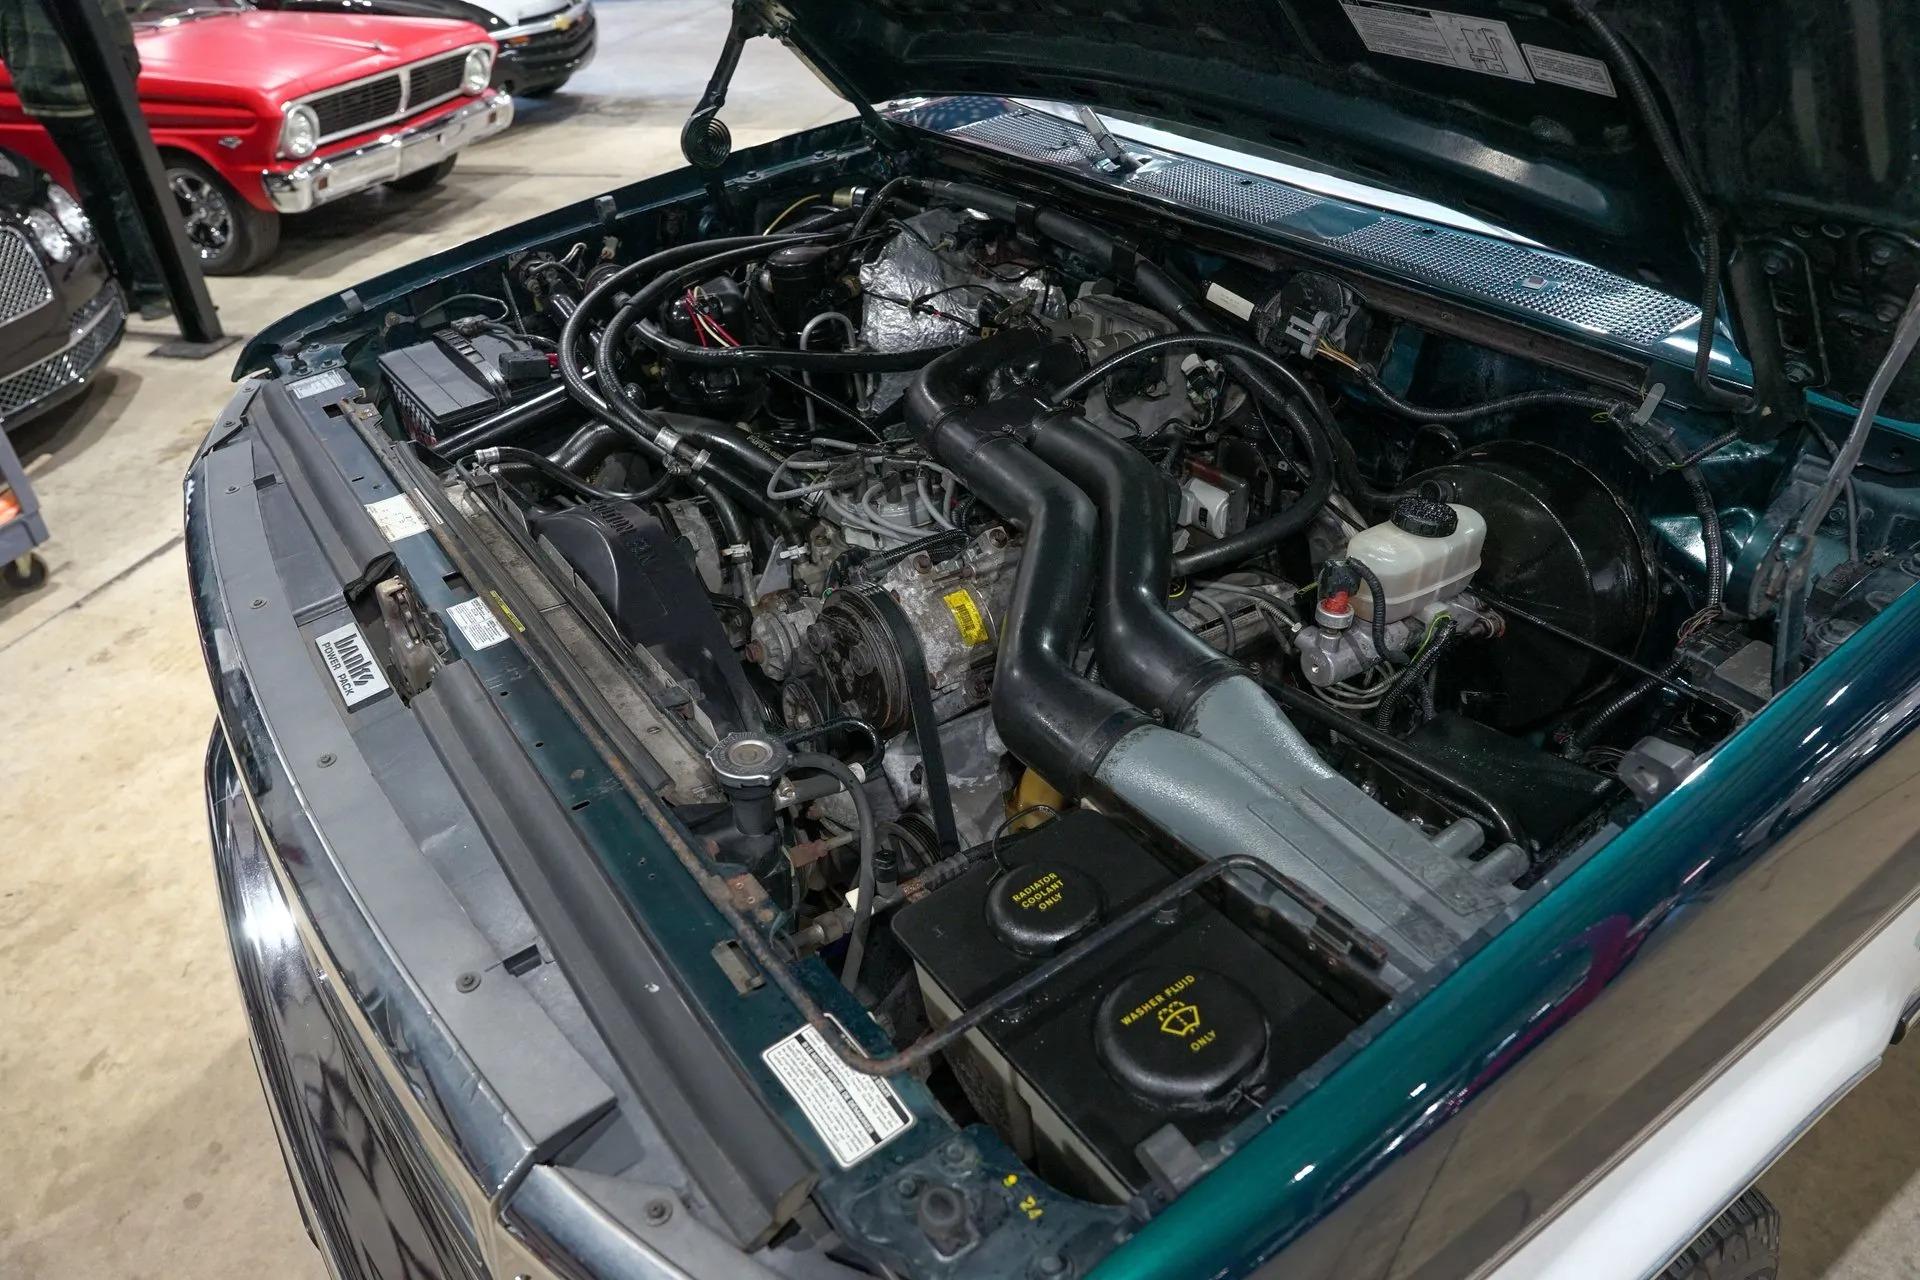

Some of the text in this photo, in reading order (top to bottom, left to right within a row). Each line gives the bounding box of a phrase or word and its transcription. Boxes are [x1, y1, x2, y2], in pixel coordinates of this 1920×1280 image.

[321, 641, 354, 696] POWER PACK
[1012, 872, 1057, 902] RADIATOR
[1021, 880, 1064, 909] COOLANT
[1038, 892, 1062, 911] ONLY
[1120, 974, 1195, 1026] WASHER FLUID
[1190, 1029, 1217, 1052] ONLY
